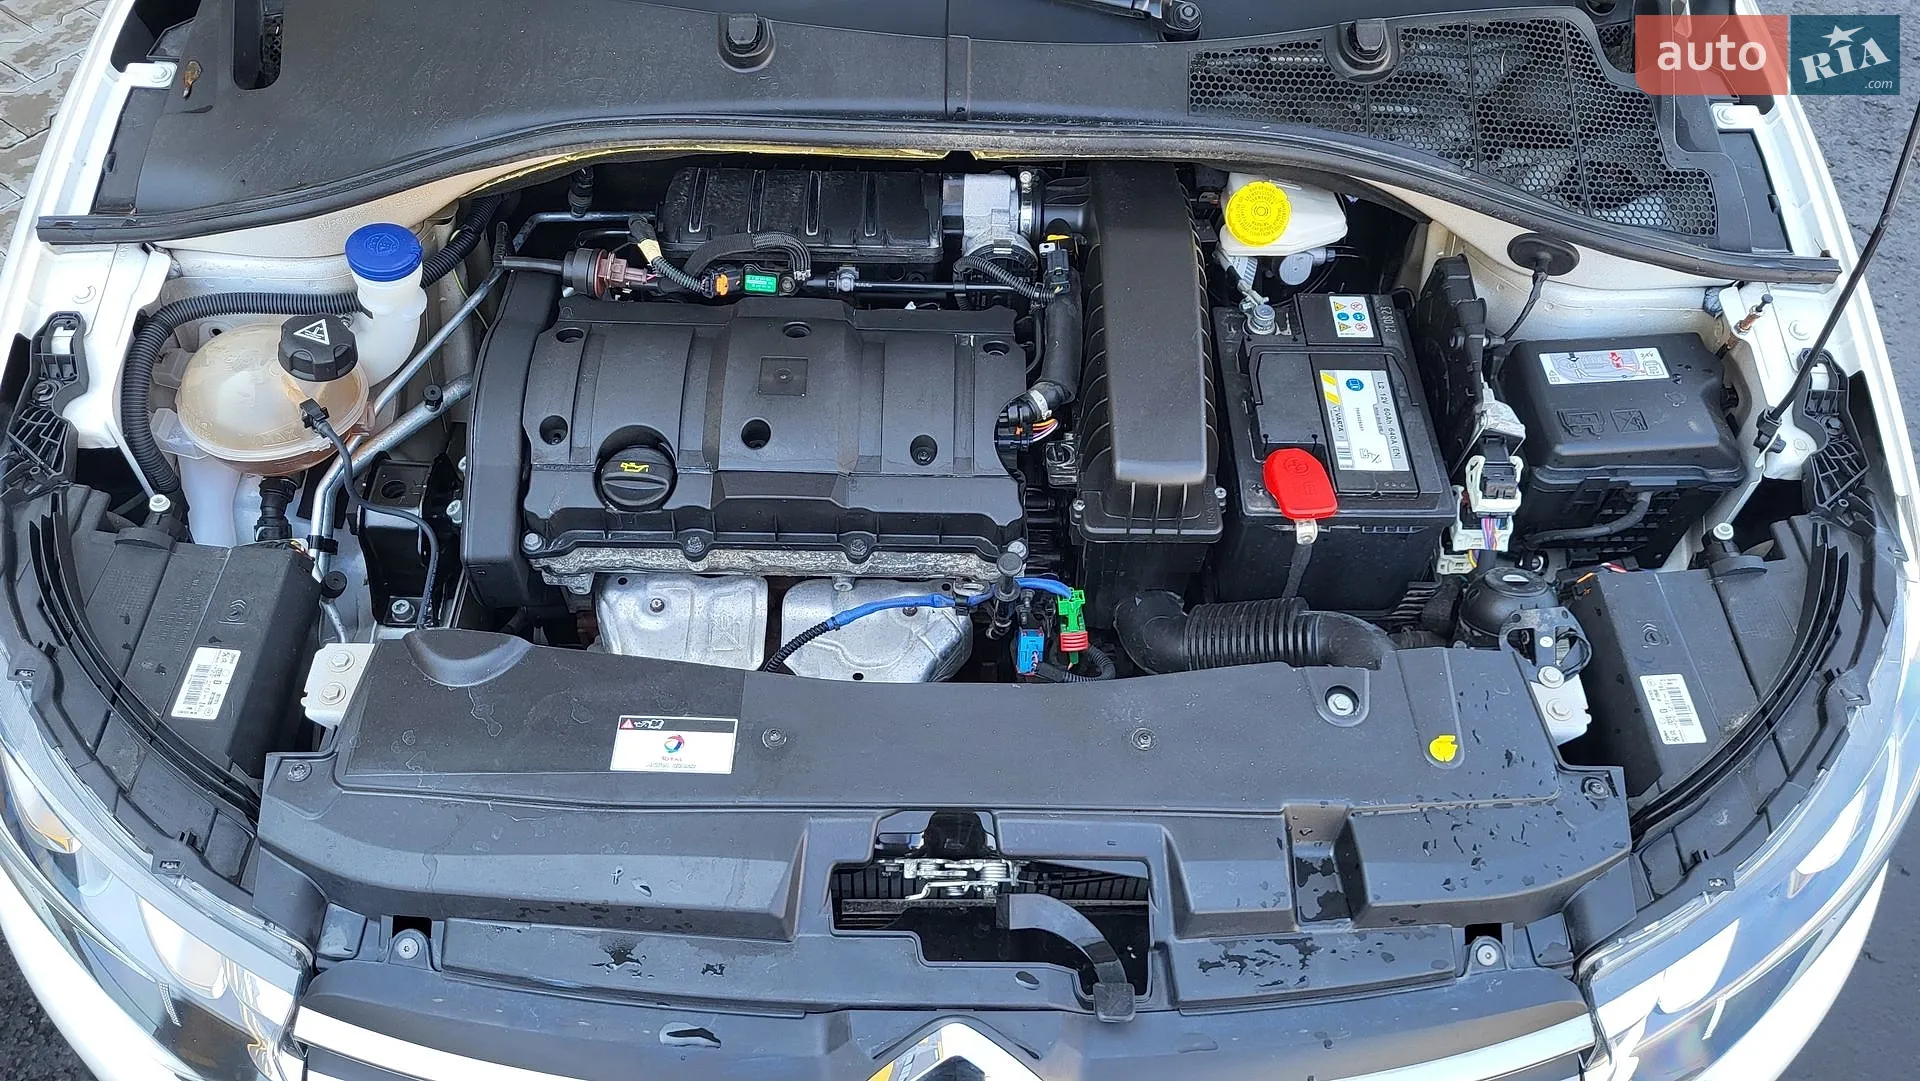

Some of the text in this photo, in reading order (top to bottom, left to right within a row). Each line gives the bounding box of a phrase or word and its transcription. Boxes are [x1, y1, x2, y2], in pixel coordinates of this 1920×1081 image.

[1335, 412, 1344, 433] VARTA
[1380, 393, 1388, 405] 12V
[1384, 408, 1392, 425] 60Ah
[1388, 427, 1398, 446] 640A
